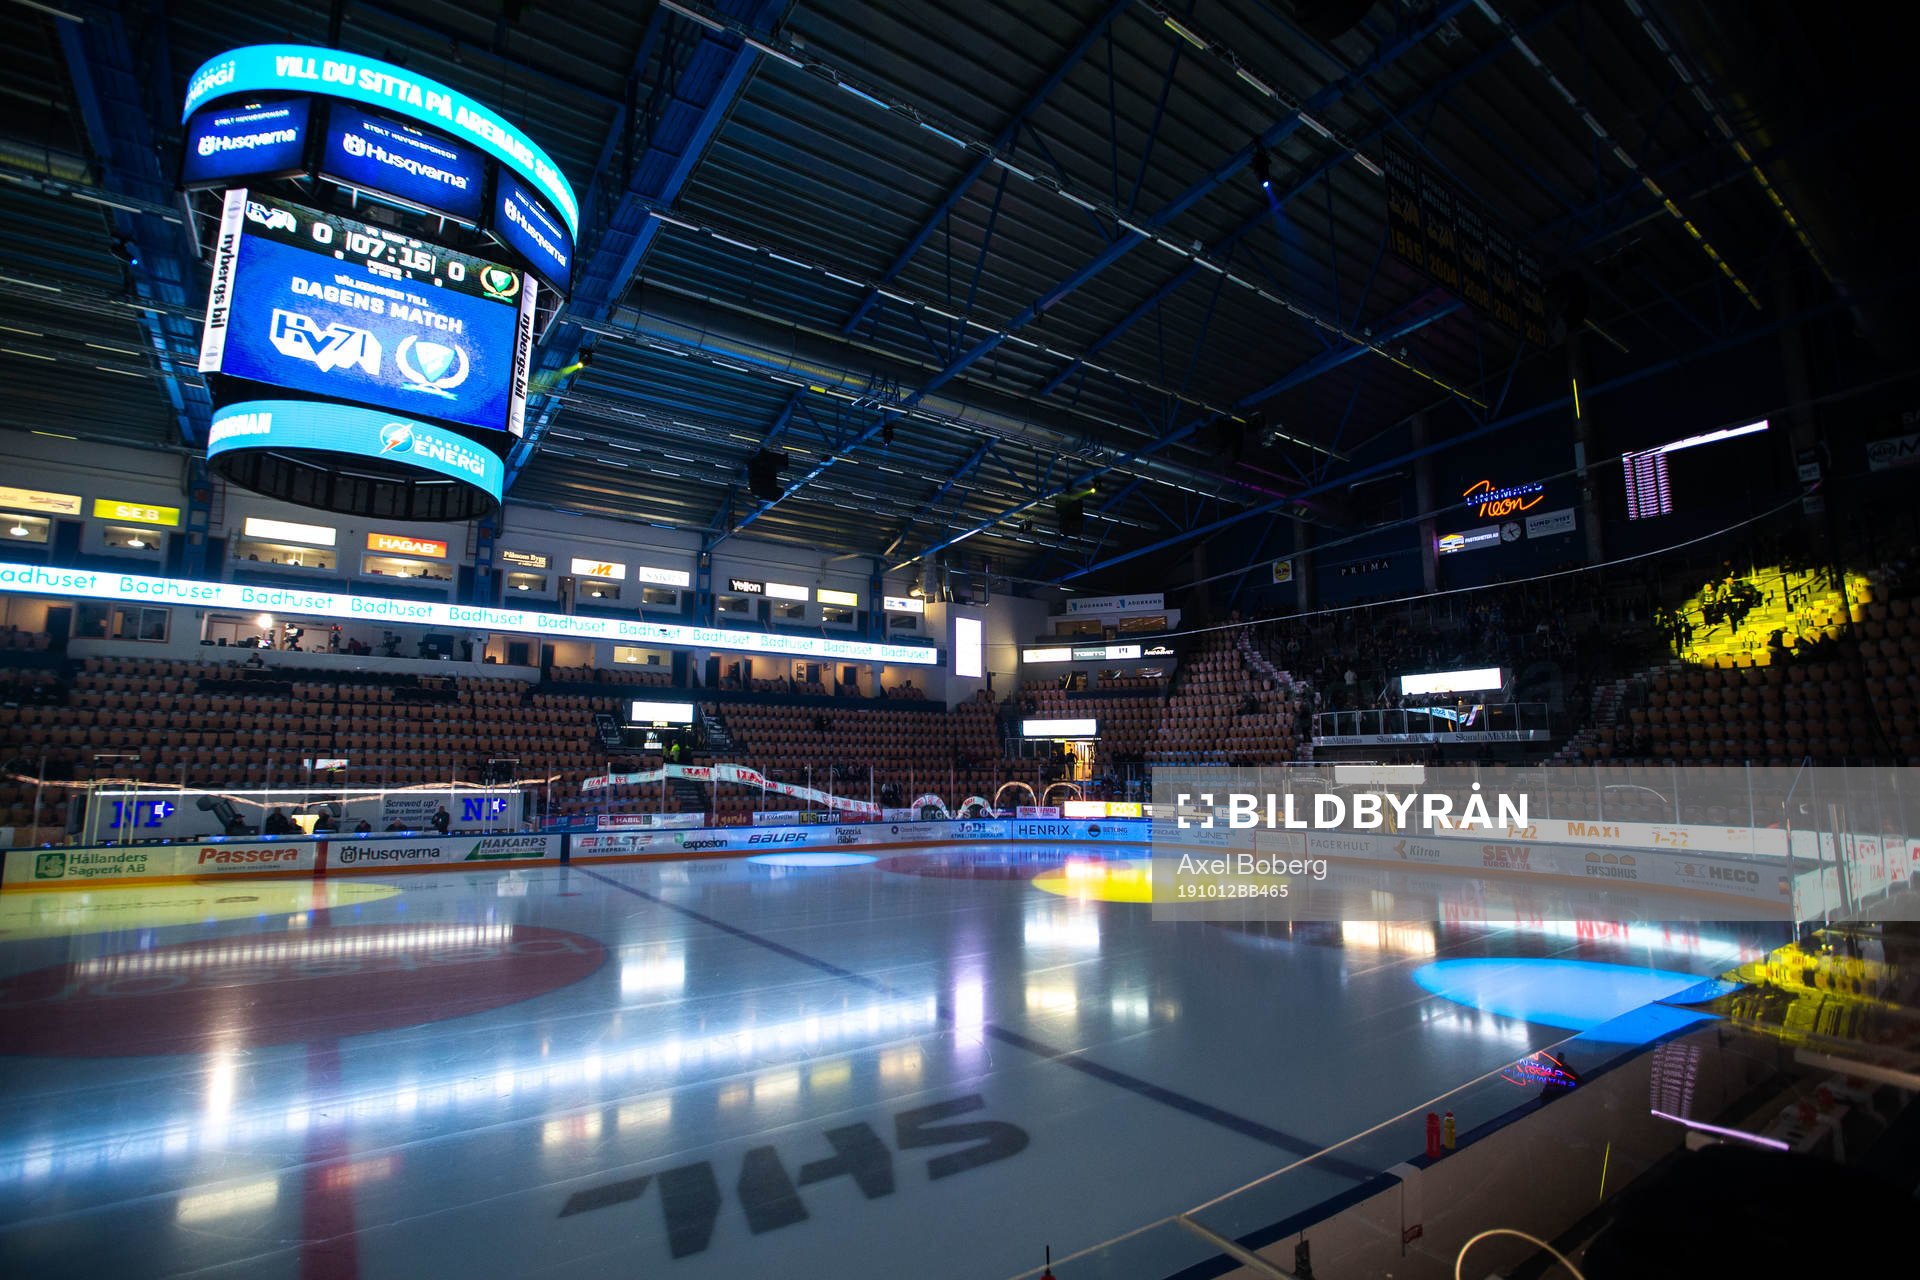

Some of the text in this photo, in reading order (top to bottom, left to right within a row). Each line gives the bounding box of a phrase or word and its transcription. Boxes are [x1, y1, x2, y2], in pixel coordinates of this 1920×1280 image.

[276, 56, 318, 80] VILL
[322, 60, 356, 85] DU
[357, 68, 422, 107] SITTA
[425, 90, 453, 120] PÅ
[215, 129, 296, 151] Husqvarna
[366, 142, 467, 189] Husqvarna
[312, 222, 333, 244] 0
[516, 210, 566, 267] Husqvarna
[448, 261, 465, 282] 0
[211, 234, 236, 329] nybergs bil
[291, 276, 463, 335] DAGENS MATCH
[515, 313, 530, 400] nybergs bil
[117, 505, 160, 521] SEB
[379, 538, 434, 553] HAGAB
[1341, 560, 1389, 577] PRIMA
[732, 580, 761, 593] Yellon
[0, 567, 929, 660] adhuset Badhuset Badhuset Badhuset Badhuset Badhuset Badhuset Badhuset Badhuset Badhuset Badhuset
[835, 828, 861, 836] Pizzeria
[1018, 825, 1069, 836] HENRIX
[481, 837, 547, 849] HAKARPS
[1310, 838, 1371, 851] FAGERHULT
[1409, 844, 1441, 858] Kitron
[198, 847, 299, 864] Passera
[358, 847, 440, 861] Husqvarna
[1483, 845, 1531, 863] SEW
[126, 864, 146, 873] AB
[1483, 860, 1531, 870] EURODRIVE
[1708, 866, 1760, 885] HECO
